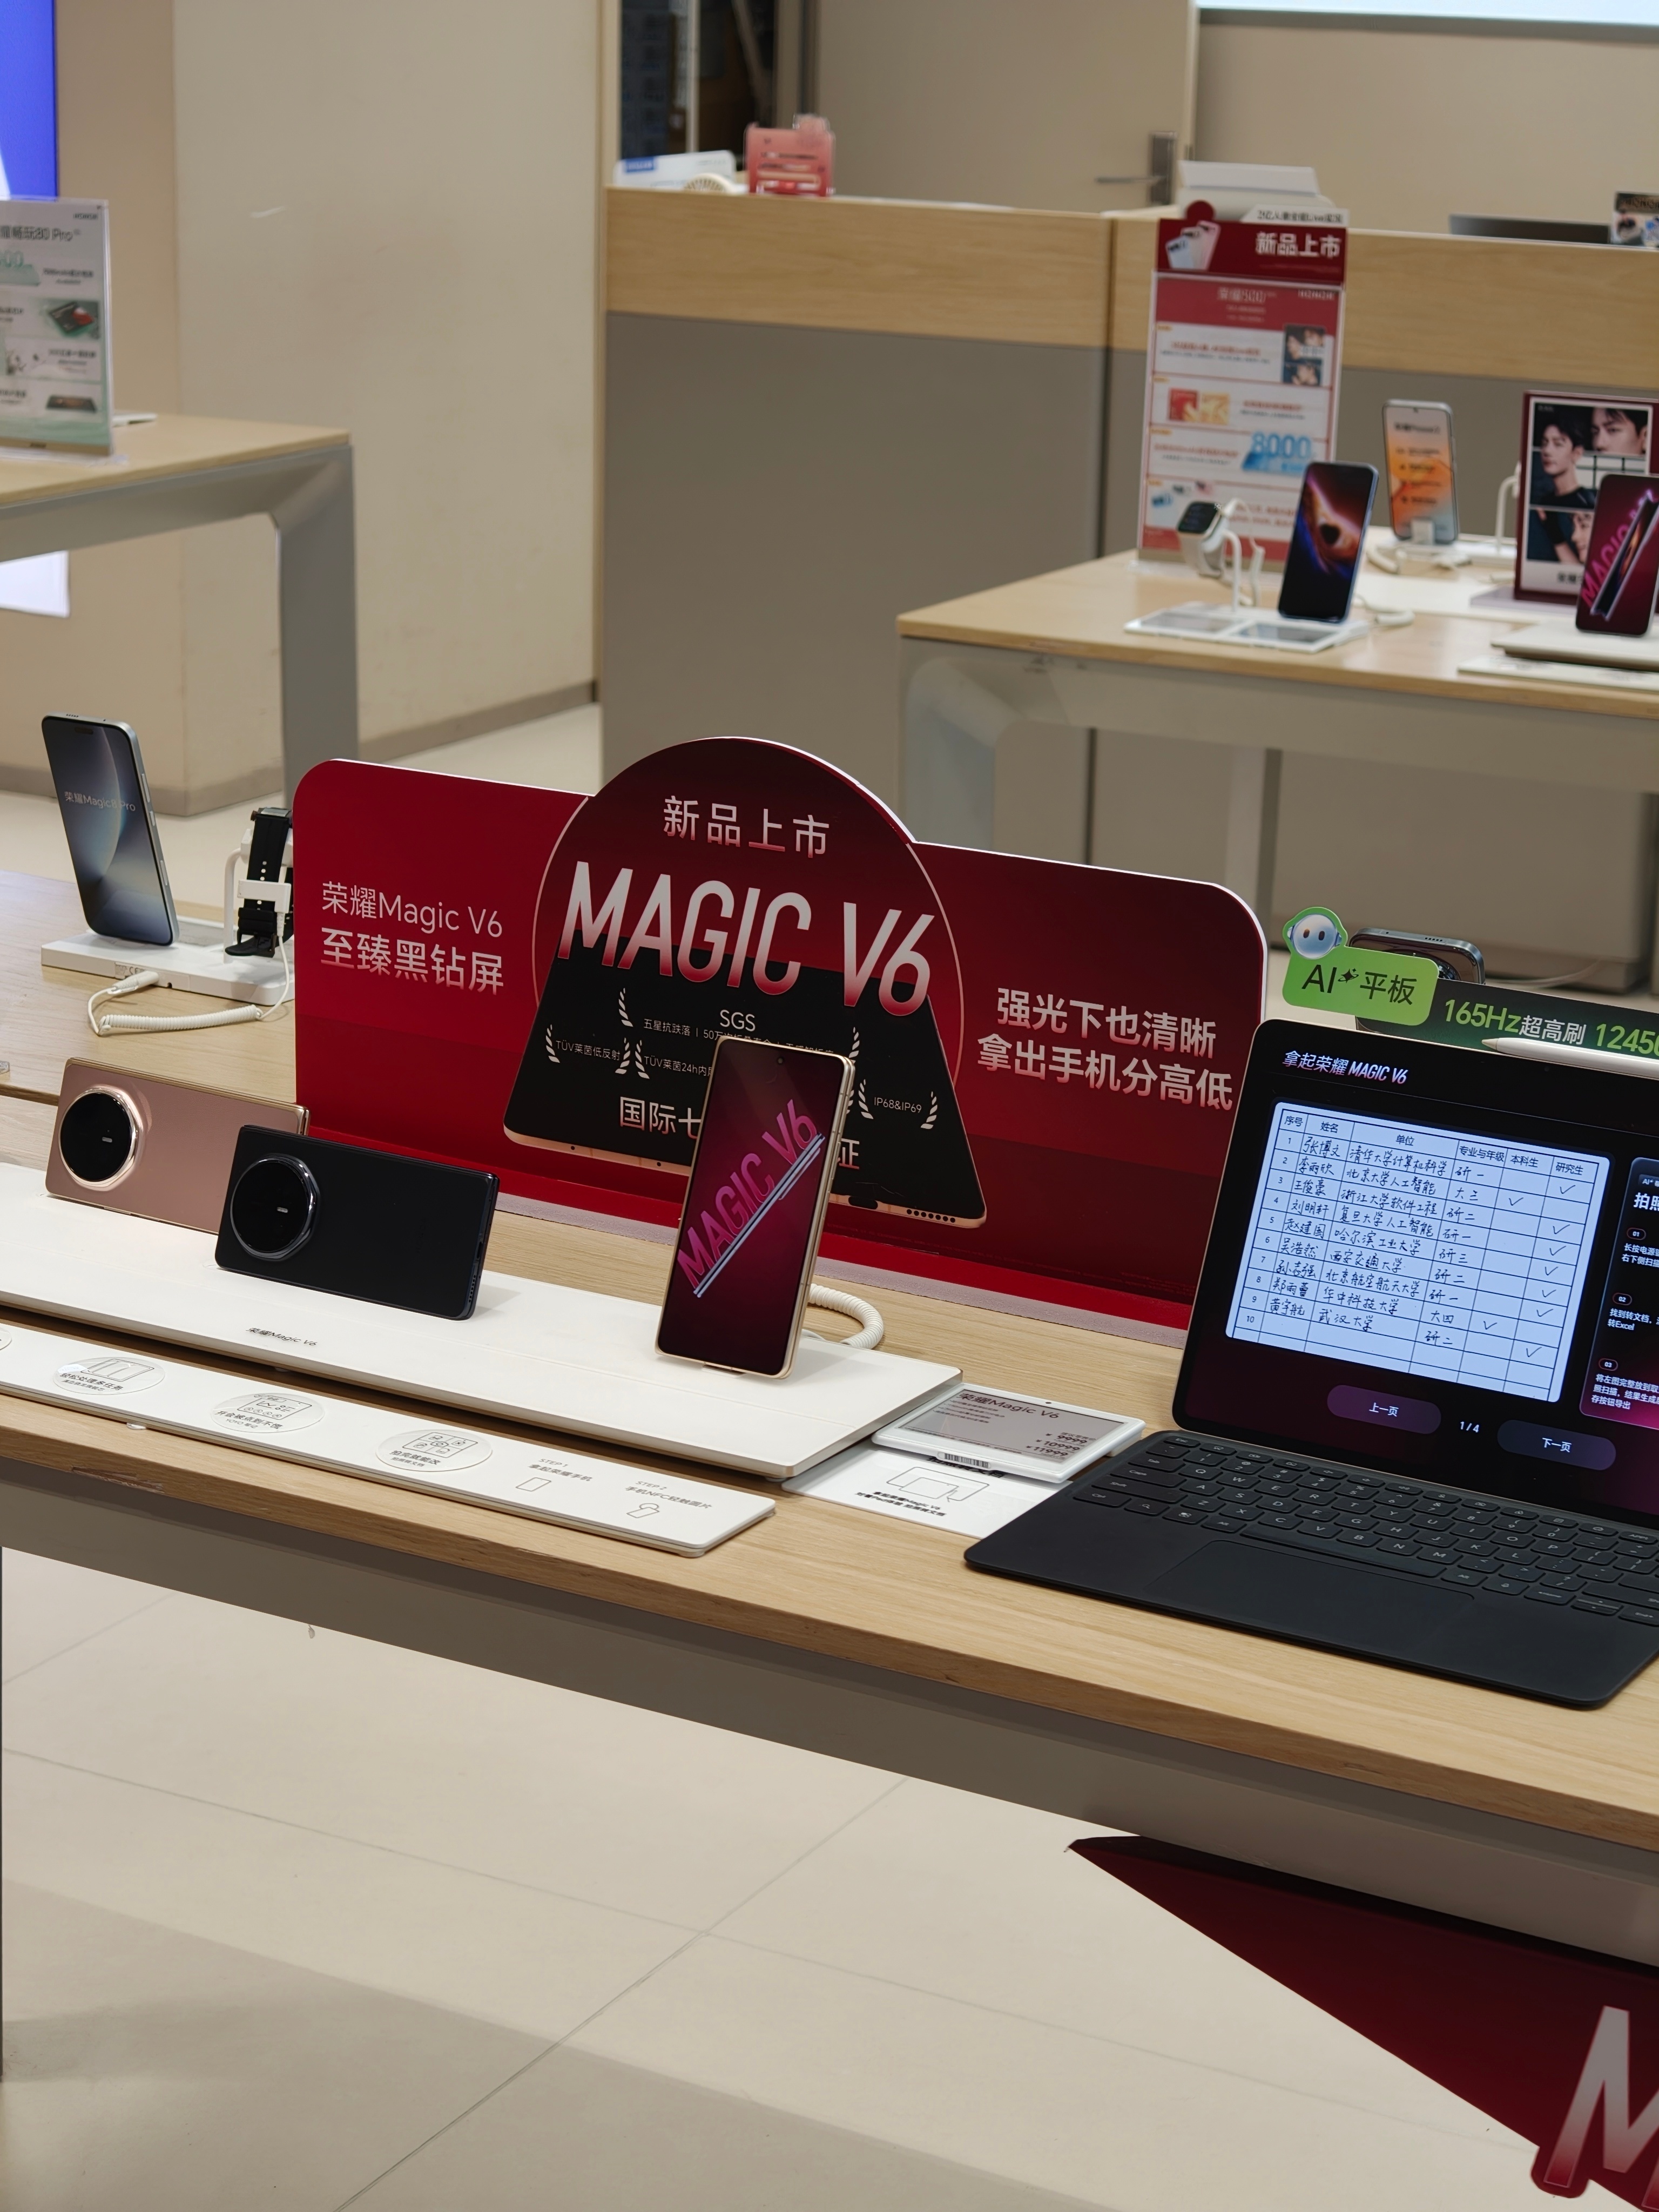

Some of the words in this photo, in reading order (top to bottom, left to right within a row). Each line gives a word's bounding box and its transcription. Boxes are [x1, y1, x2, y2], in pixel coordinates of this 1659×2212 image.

[1256, 231, 1342, 259] 新品上市
[1251, 430, 1312, 460] 8000
[120, 800, 136, 812] Pro
[663, 795, 830, 859] 新品上市
[322, 881, 460, 934] 荣耀Magic
[468, 906, 502, 938] V6
[557, 861, 811, 995] MAGIC
[843, 901, 935, 1017] V6
[321, 927, 504, 995] 至臻黑钻屏
[1359, 971, 1417, 1006] 平板
[644, 1019, 691, 1036] 五星抗跌落
[720, 1009, 756, 1032] SGS
[997, 988, 1216, 1059] 强光下也清晰
[1444, 999, 1587, 1046] 165Hz超高刷
[556, 1040, 621, 1061] TÜV莱茵低反射
[1282, 1050, 1349, 1076] 拿起荣耀
[1347, 1061, 1390, 1081] MAGIC
[1392, 1068, 1409, 1084] V6
[977, 1034, 1233, 1110] 拿出手机分高低
[874, 1097, 922, 1114] IP68&IP69
[1284, 1115, 1303, 1127] 序号
[1320, 1121, 1339, 1133] 姓名
[1395, 1135, 1415, 1146] 单位
[1459, 1145, 1505, 1162] 专业与年级
[1510, 1154, 1539, 1168] 本科生
[1555, 1162, 1583, 1176] 研究生
[1303, 1136, 1340, 1158] 张博文
[1349, 1144, 1447, 1176] 清华大学计算机科学
[1455, 1166, 1484, 1181] 研一
[1299, 1156, 1334, 1175] 李雨欣
[1346, 1168, 1436, 1195] 北京大学人工智能
[677, 1153, 775, 1289] MAGIC
[761, 1099, 817, 1165] V6
[1294, 1178, 1326, 1196] 王俊豪
[1341, 1189, 1438, 1217] 浙江大学软件工程
[1446, 1206, 1475, 1223] 研二
[1284, 1218, 1326, 1239] 赵建国
[1334, 1230, 1421, 1256] 哈尔滨工业大学
[1439, 1248, 1468, 1264] 研三
[1339, 1205, 1434, 1237] 复旦大学人工智能
[1442, 1229, 1471, 1242] 研一
[1281, 1237, 1318, 1259] 吴浩然
[1330, 1249, 1402, 1272] 西安交通大学
[1434, 1269, 1465, 1284] 研二
[1323, 1286, 1400, 1315] 华中科技大学
[1325, 1269, 1420, 1297] 北京航空航天大学
[1428, 1290, 1458, 1304] 研一
[246, 1327, 301, 1341] 荣耀Magic
[1319, 1308, 1373, 1332] 武汉大学
[1425, 1331, 1453, 1346] 研二
[1607, 1318, 1635, 1331] 转Excel
[955, 1393, 1037, 1415] 荣耀Magic
[1040, 1410, 1060, 1420] V6
[1368, 1402, 1399, 1418] 上一页
[1033, 1446, 1068, 1456] 11999
[1044, 1441, 1080, 1451] 10999
[1057, 1435, 1087, 1444] 9999
[1541, 1437, 1572, 1453] 下一页
